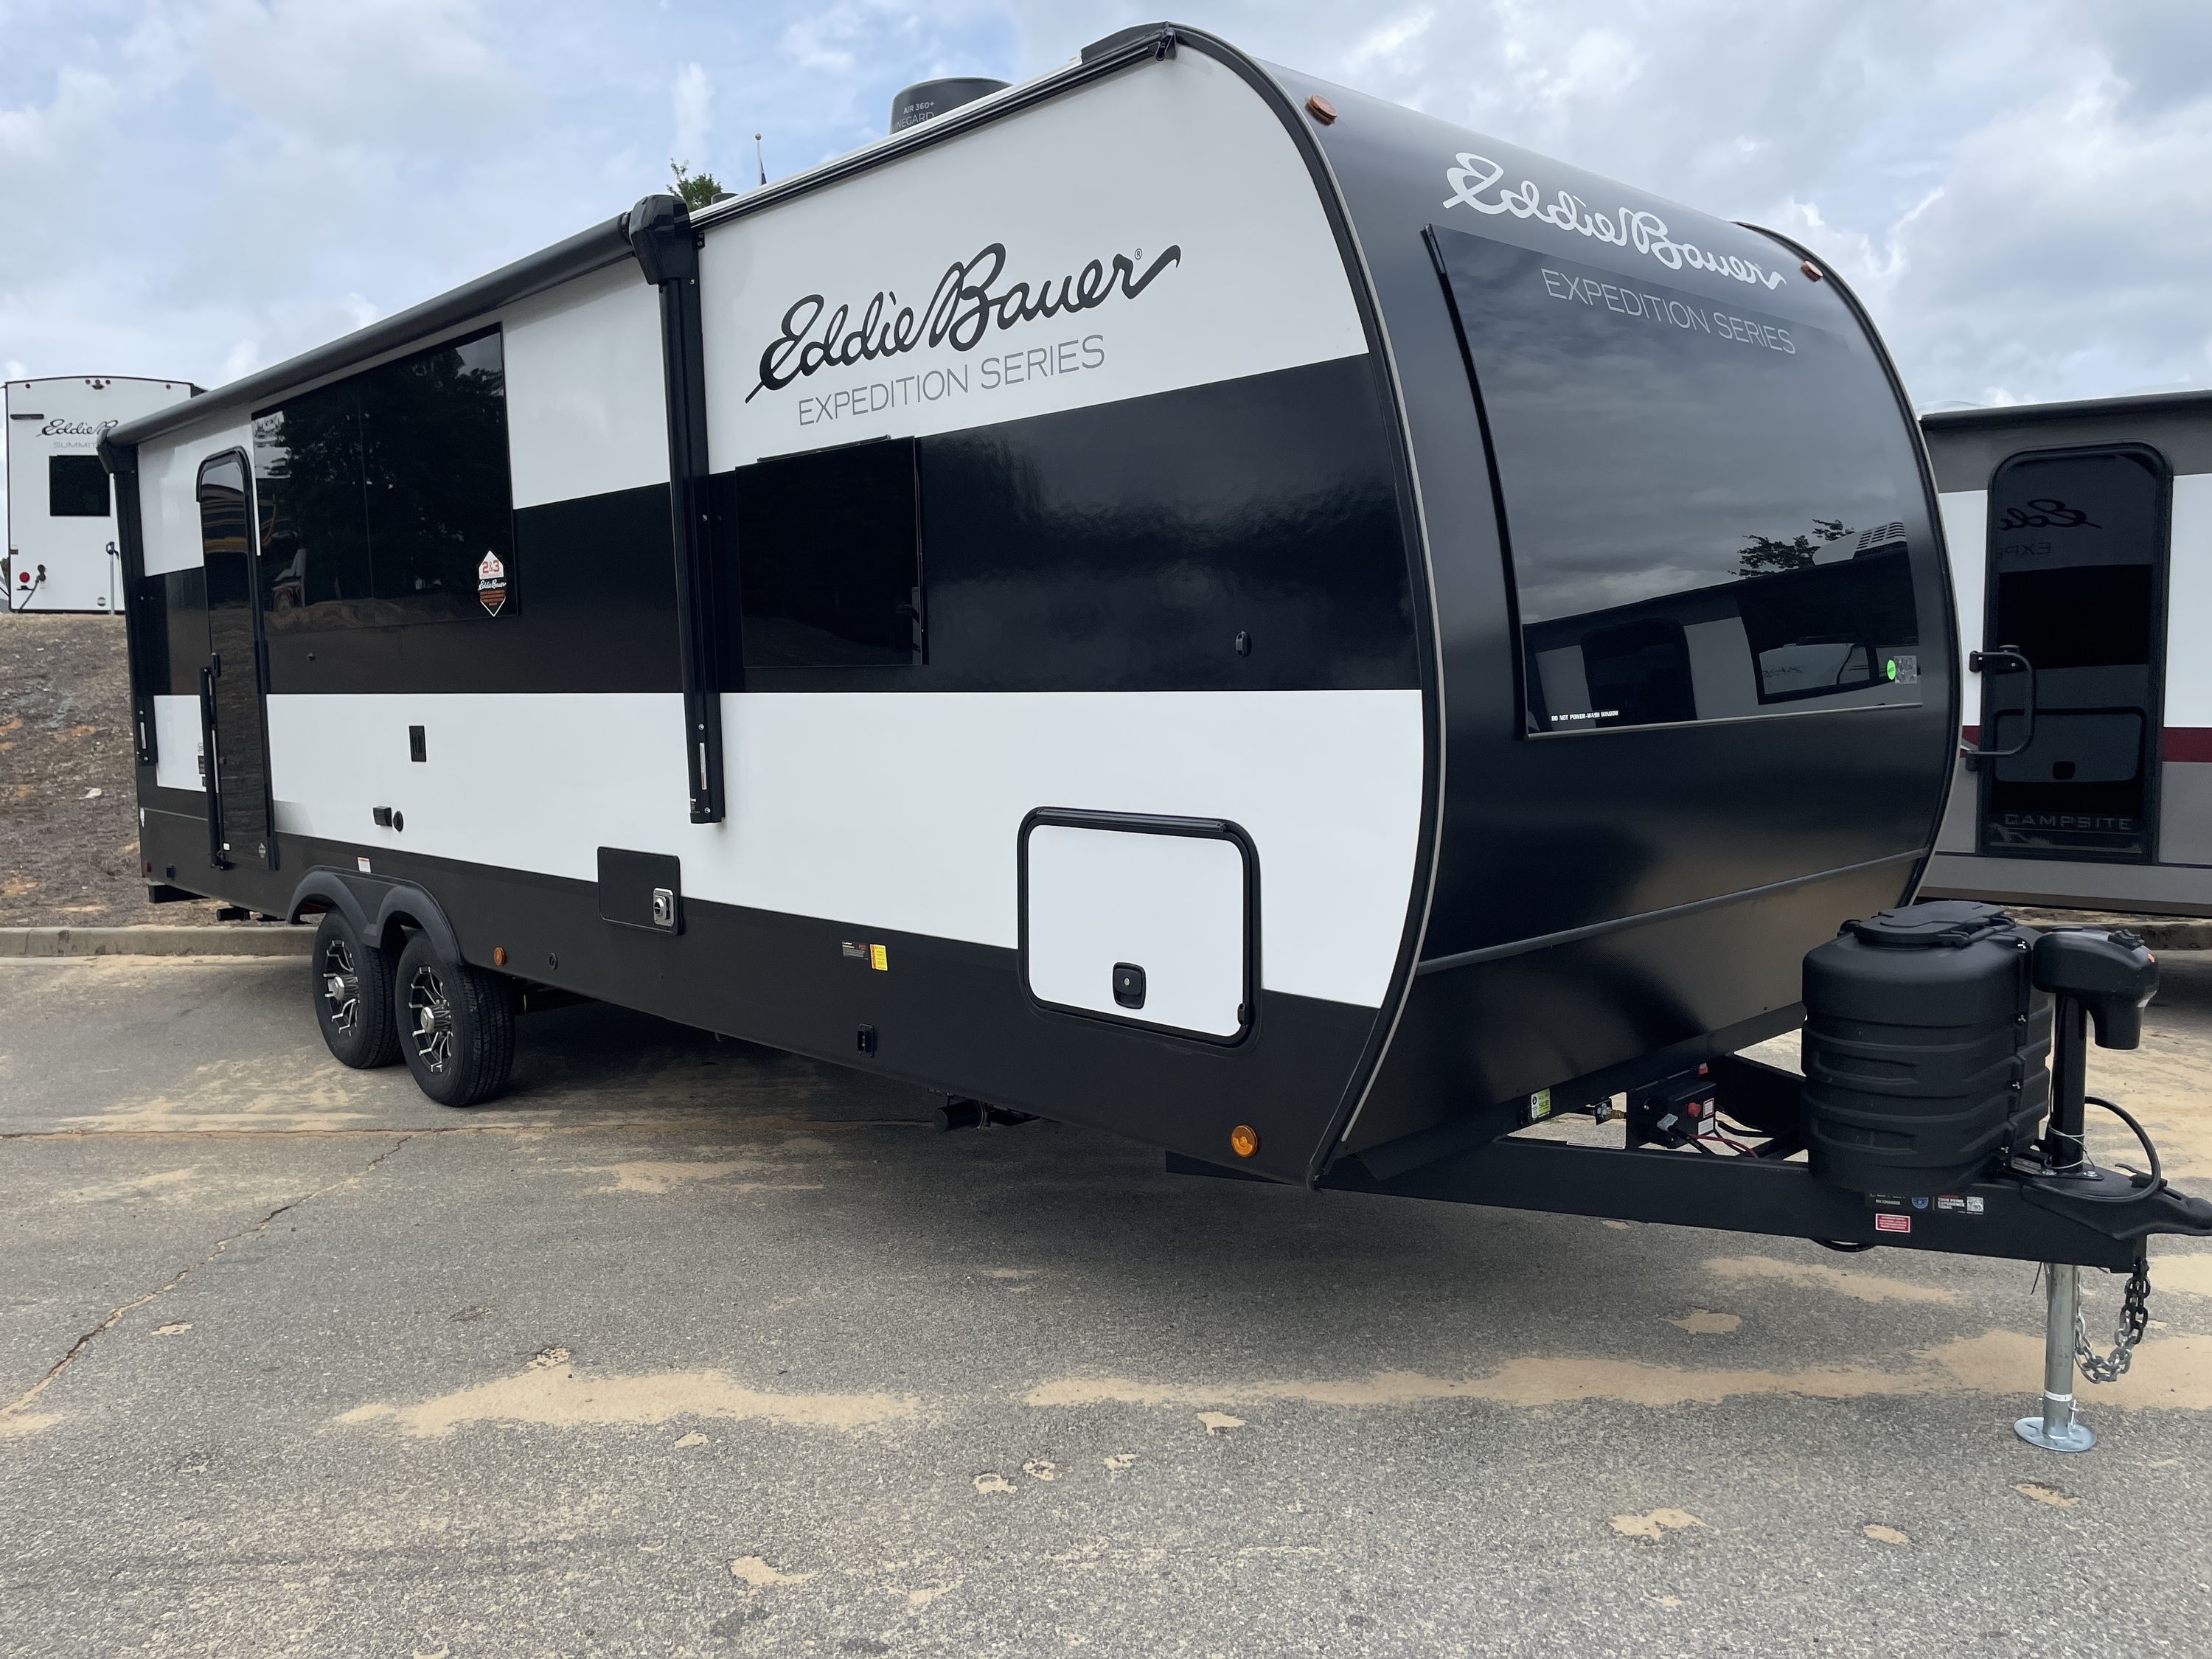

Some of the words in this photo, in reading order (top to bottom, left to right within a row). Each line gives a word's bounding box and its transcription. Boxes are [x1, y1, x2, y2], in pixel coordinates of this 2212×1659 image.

[903, 105, 914, 114] AIR
[915, 101, 935, 111] 360+
[1442, 152, 1620, 243] Eddie
[1618, 206, 1787, 291] Bauer
[745, 291, 916, 404] Eddie
[928, 242, 1181, 352] Bauer
[1540, 268, 1711, 334] EXPEDITION
[1713, 311, 1796, 355] SERIES
[799, 364, 968, 426] EXPEDITION
[981, 334, 1105, 389] SERIES
[35, 419, 93, 437] Eddie
[2005, 814, 2132, 830] CAMPSITE
